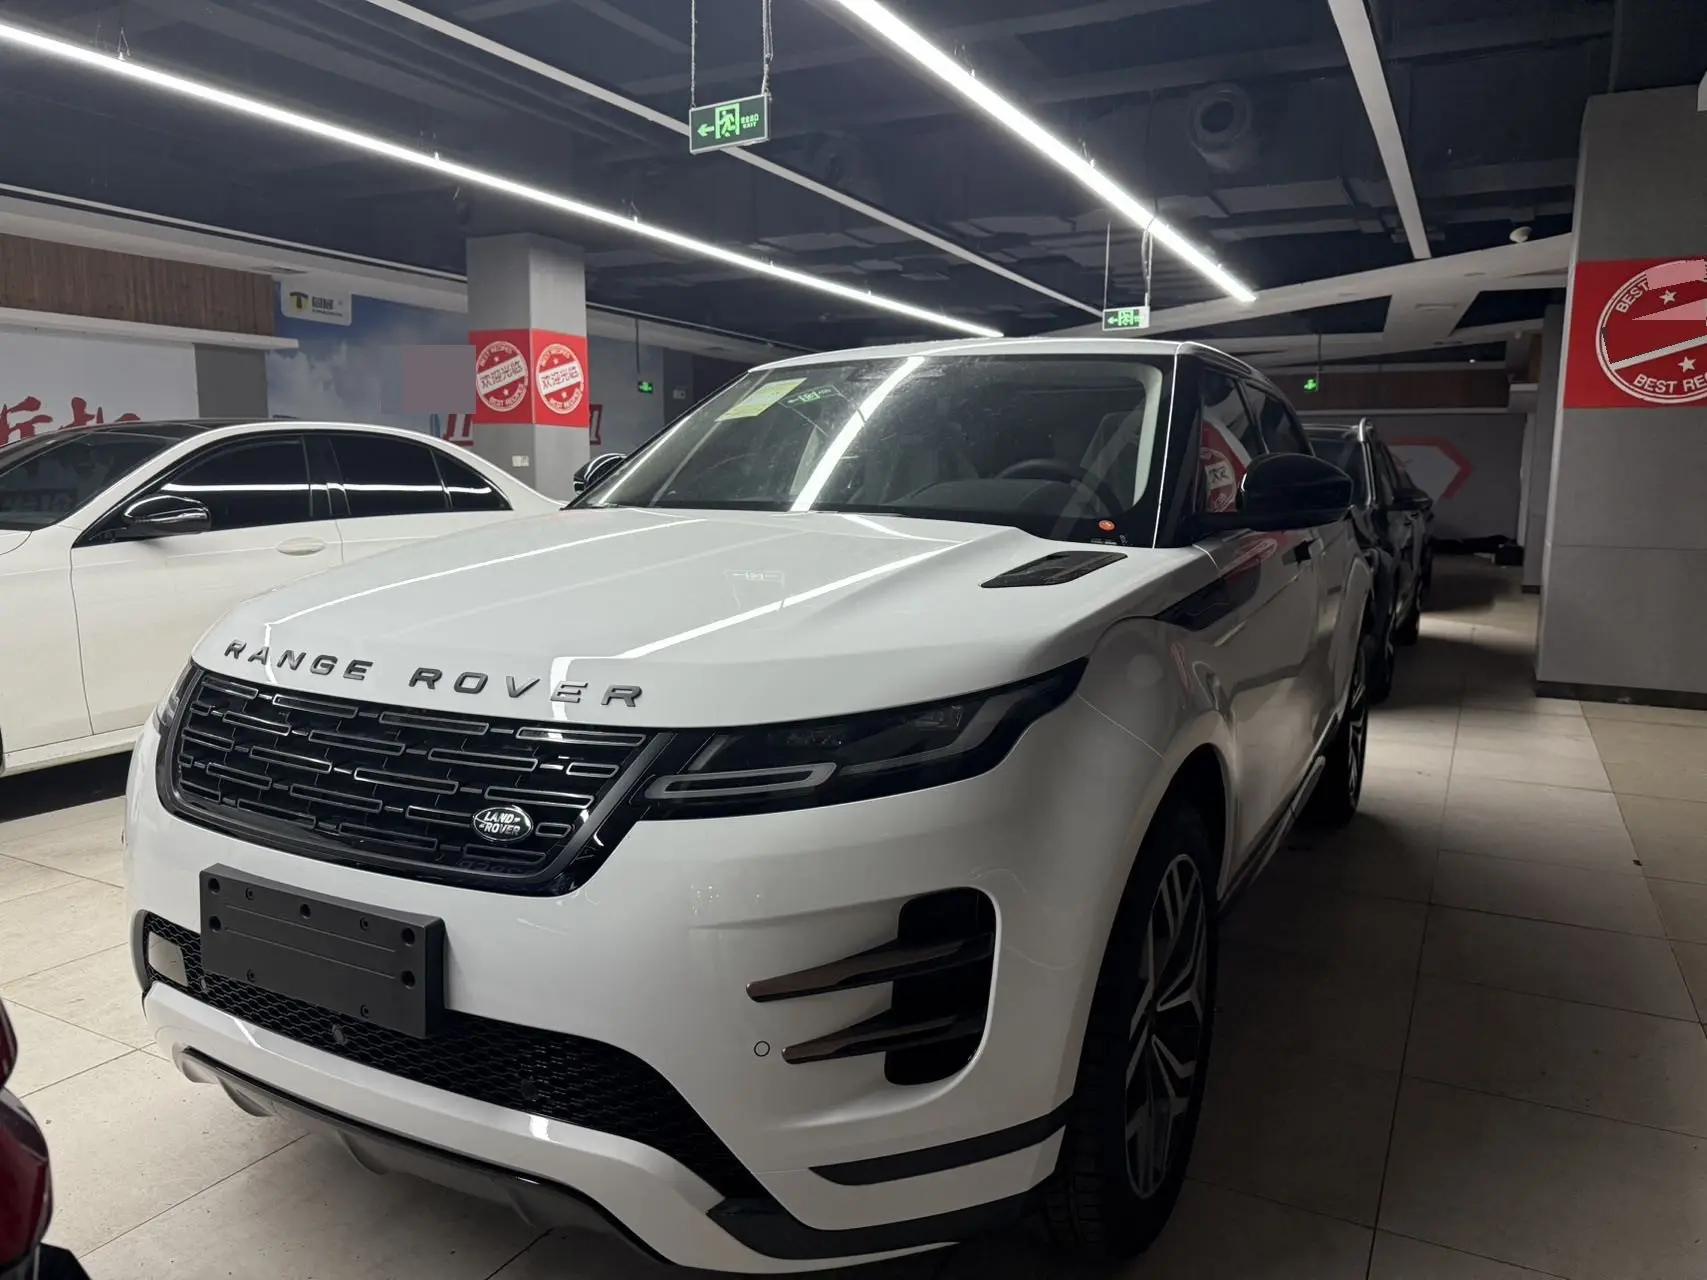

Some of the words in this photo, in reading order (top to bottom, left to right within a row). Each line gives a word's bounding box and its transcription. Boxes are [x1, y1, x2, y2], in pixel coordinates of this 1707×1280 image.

[1615, 279, 1649, 313] BEST
[1633, 373, 1677, 394] BEST
[1682, 372, 1707, 392] RE
[224, 639, 373, 681] RANGE
[408, 667, 645, 708] ROVER
[483, 811, 514, 824] LAND
[484, 822, 521, 836] ROVER
